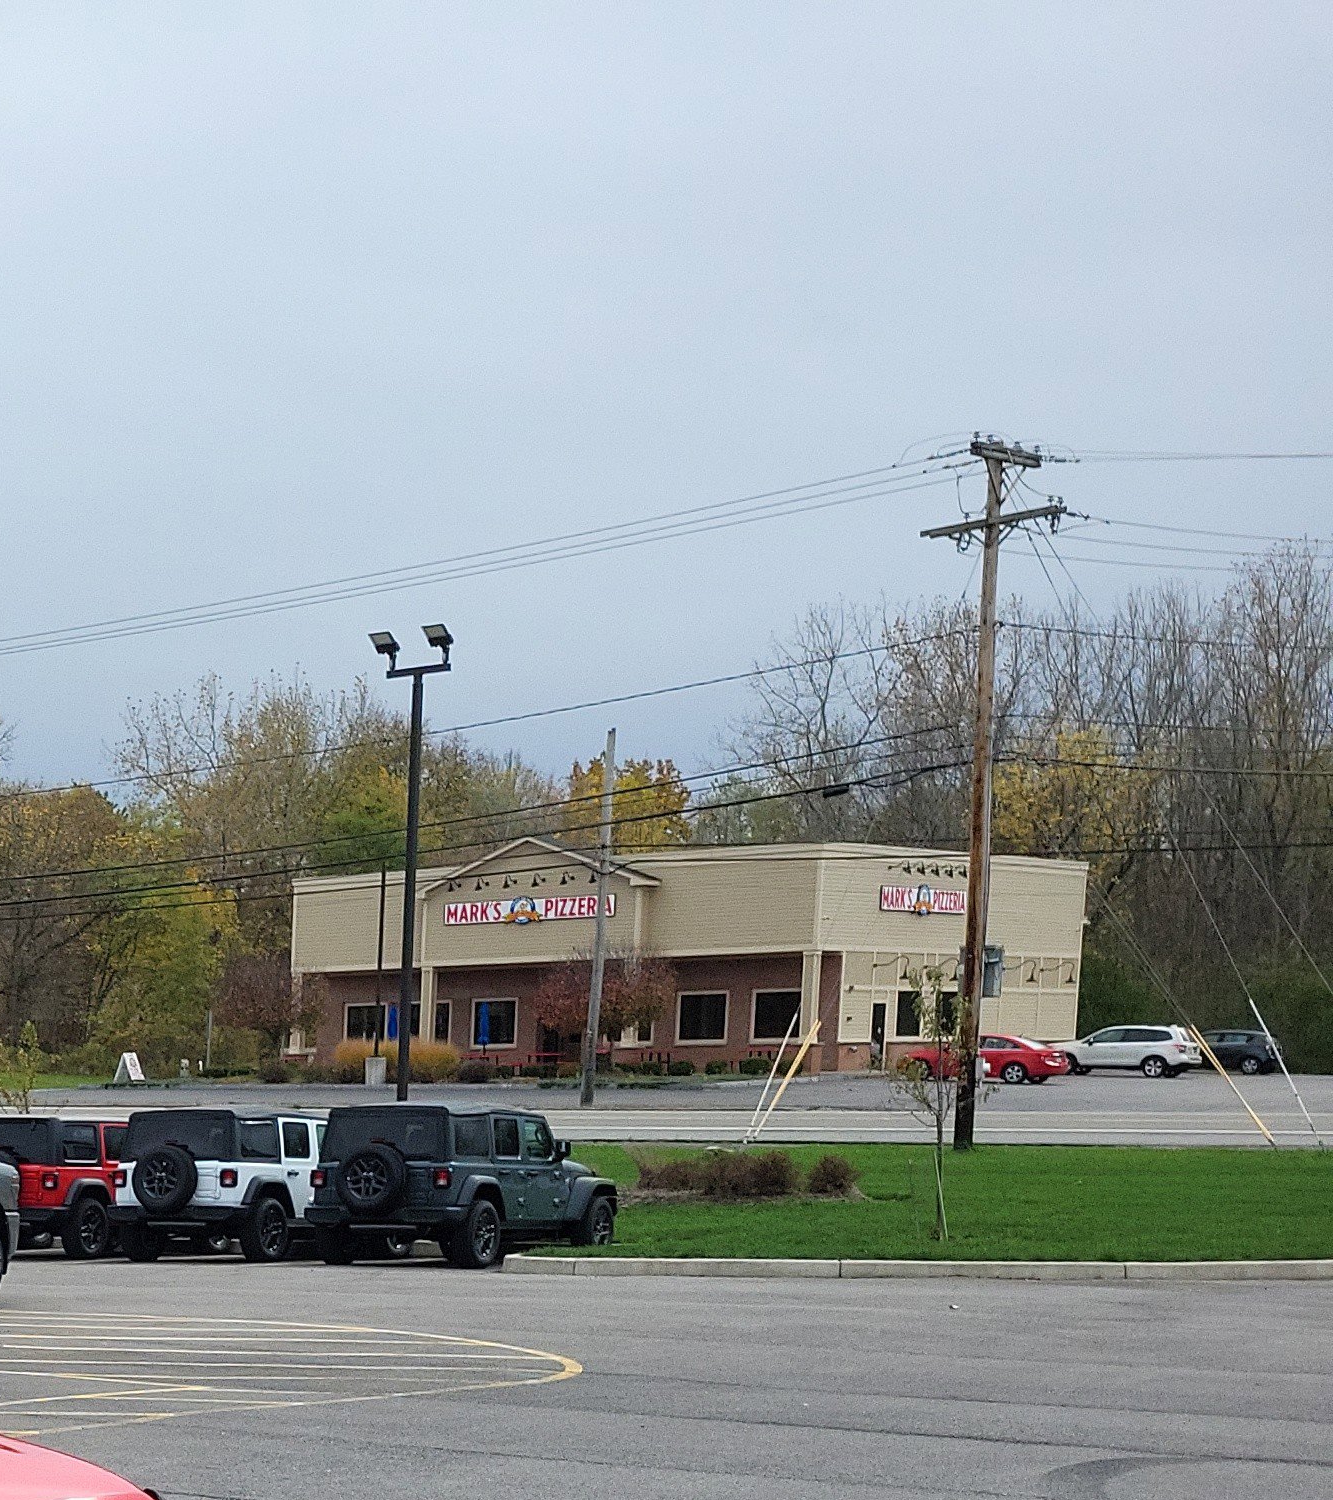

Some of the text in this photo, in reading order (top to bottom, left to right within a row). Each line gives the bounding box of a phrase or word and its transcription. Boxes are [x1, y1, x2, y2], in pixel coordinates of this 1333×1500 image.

[446, 896, 612, 923] MARK'S PIZZERA
[933, 891, 966, 911] PIZZERIA
